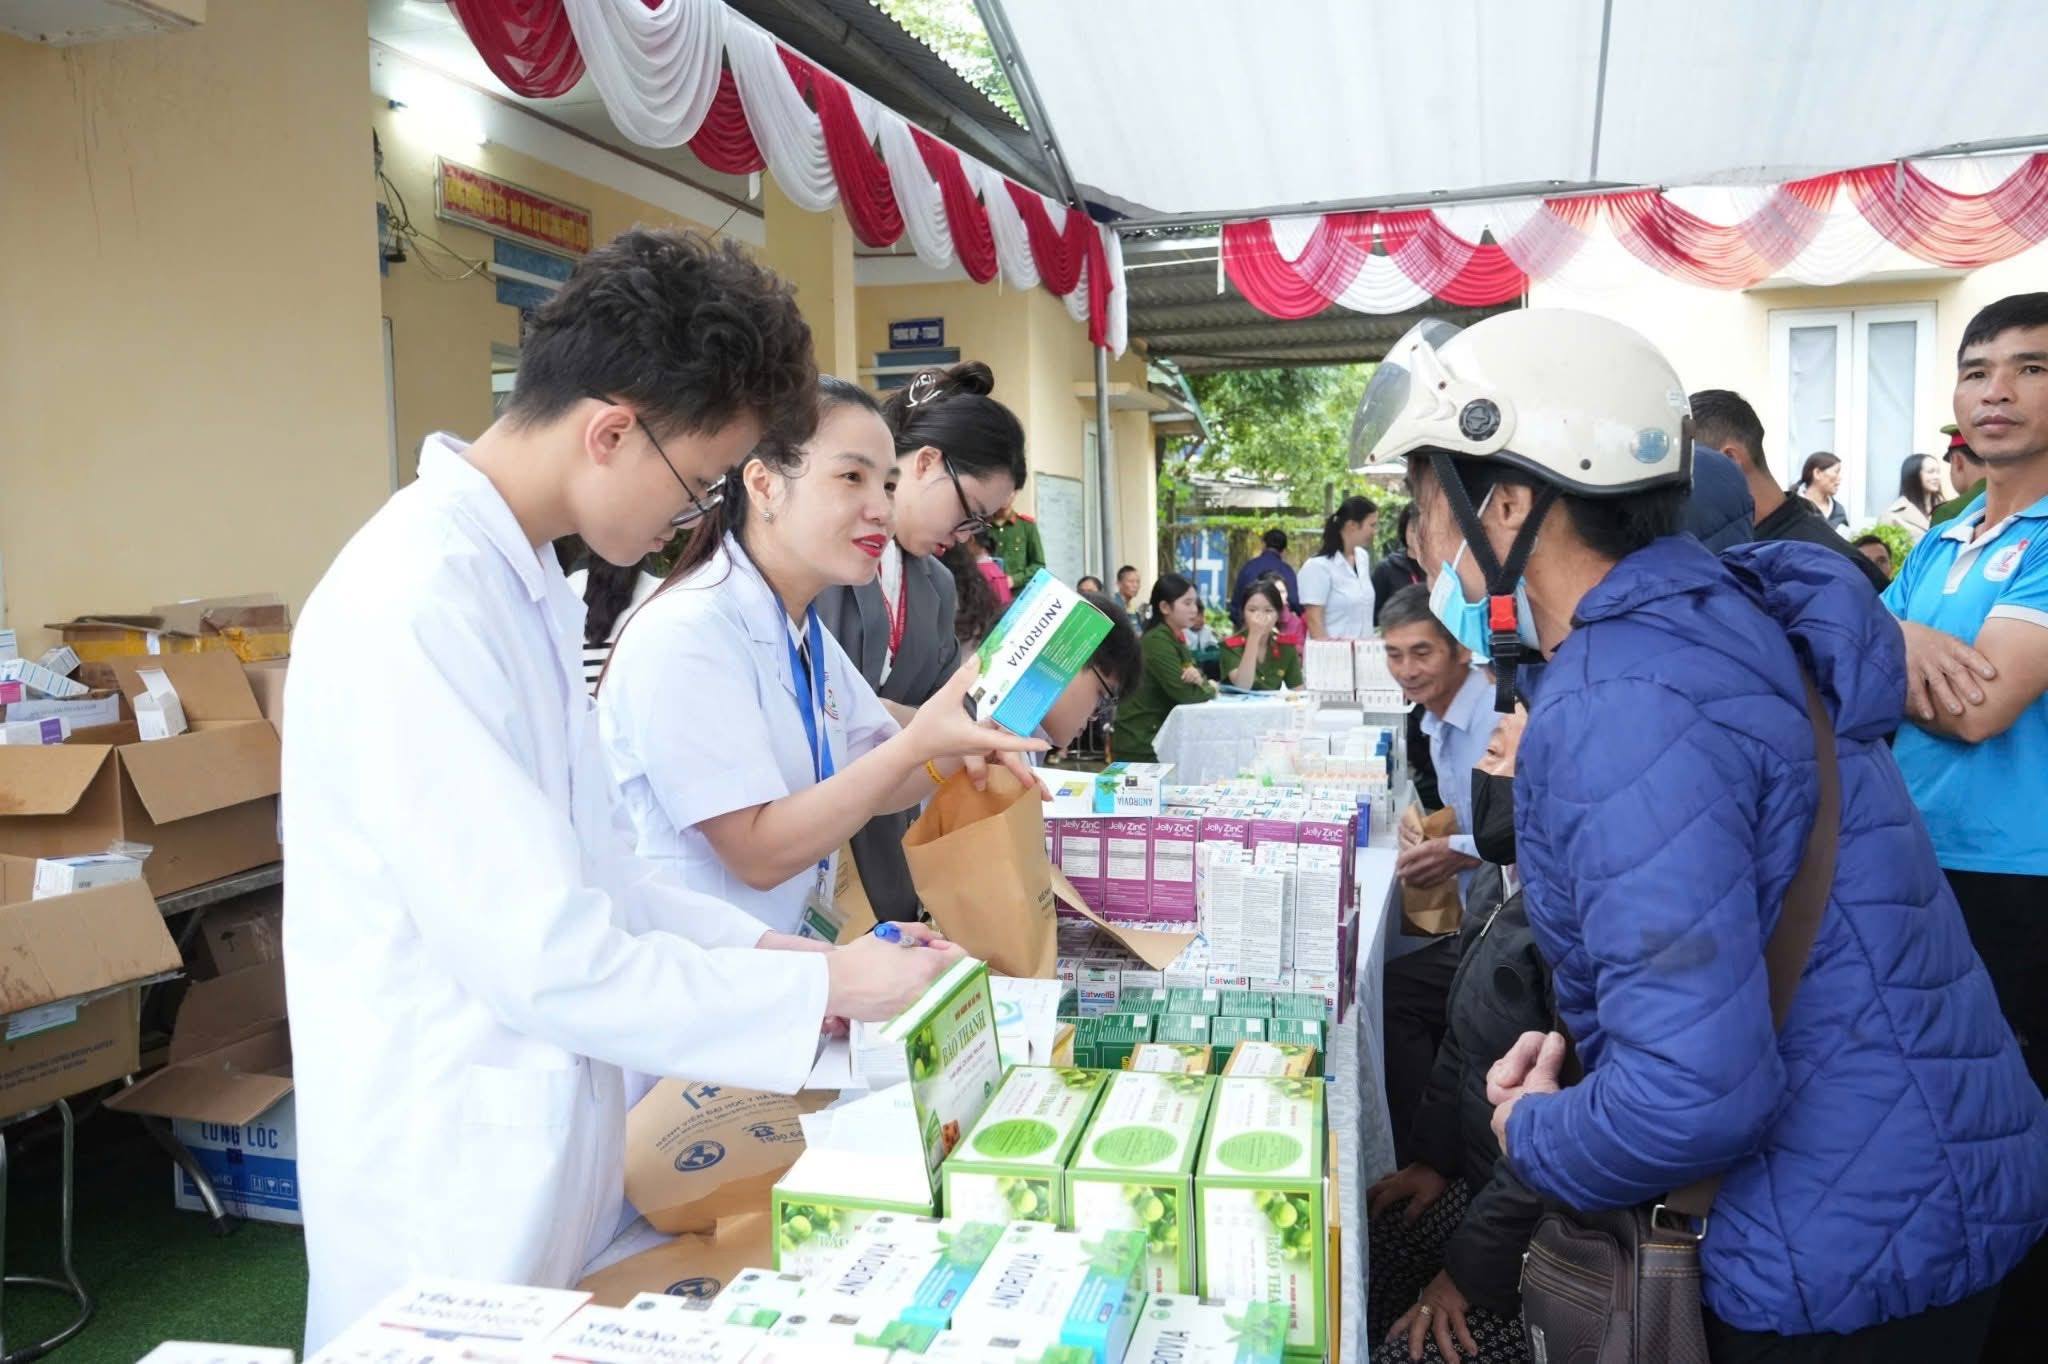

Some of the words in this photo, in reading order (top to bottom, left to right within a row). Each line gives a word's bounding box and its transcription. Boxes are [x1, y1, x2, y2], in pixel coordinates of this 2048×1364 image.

[1007, 598, 1063, 667] ANDROVIA
[1063, 820, 1080, 830] Jelly
[1081, 820, 1100, 829] ZinC
[1109, 822, 1126, 832] Jelly
[1127, 822, 1147, 832] ZinC
[1155, 824, 1173, 833] Jelly
[1174, 823, 1194, 833] ZinC
[1205, 823, 1223, 834] Jelly
[1224, 824, 1244, 833] ZinC
[1303, 828, 1321, 838] Jelly
[1322, 828, 1343, 838] ZinC
[1209, 976, 1247, 986] EatwellB
[1080, 989, 1115, 999] EatwellB
[958, 1009, 987, 1051] THANH
[1267, 1274, 1282, 1304] THA
